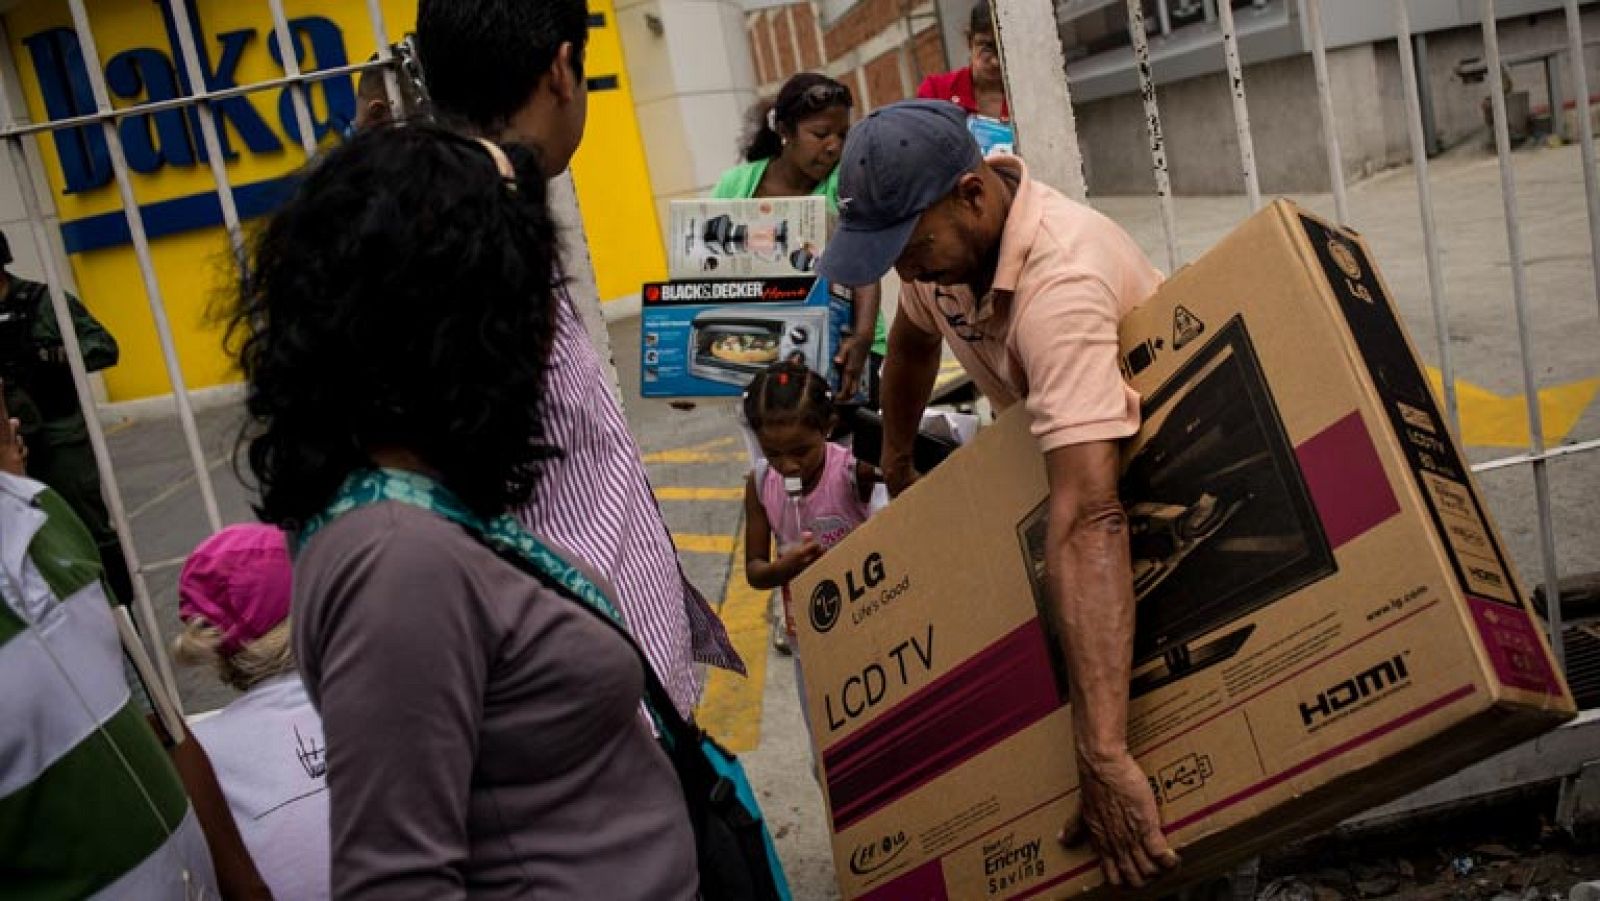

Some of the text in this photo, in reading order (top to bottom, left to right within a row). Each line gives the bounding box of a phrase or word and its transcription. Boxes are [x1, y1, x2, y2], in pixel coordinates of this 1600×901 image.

[22, 0, 359, 194] Daka
[661, 281, 764, 300] BLACK&DECKER
[845, 552, 886, 604] LG
[880, 574, 911, 604] Good
[824, 623, 934, 731] LCD TV
[1299, 654, 1408, 726] HDMI
[984, 837, 1042, 876] Energy
[988, 860, 1045, 895] Saving
